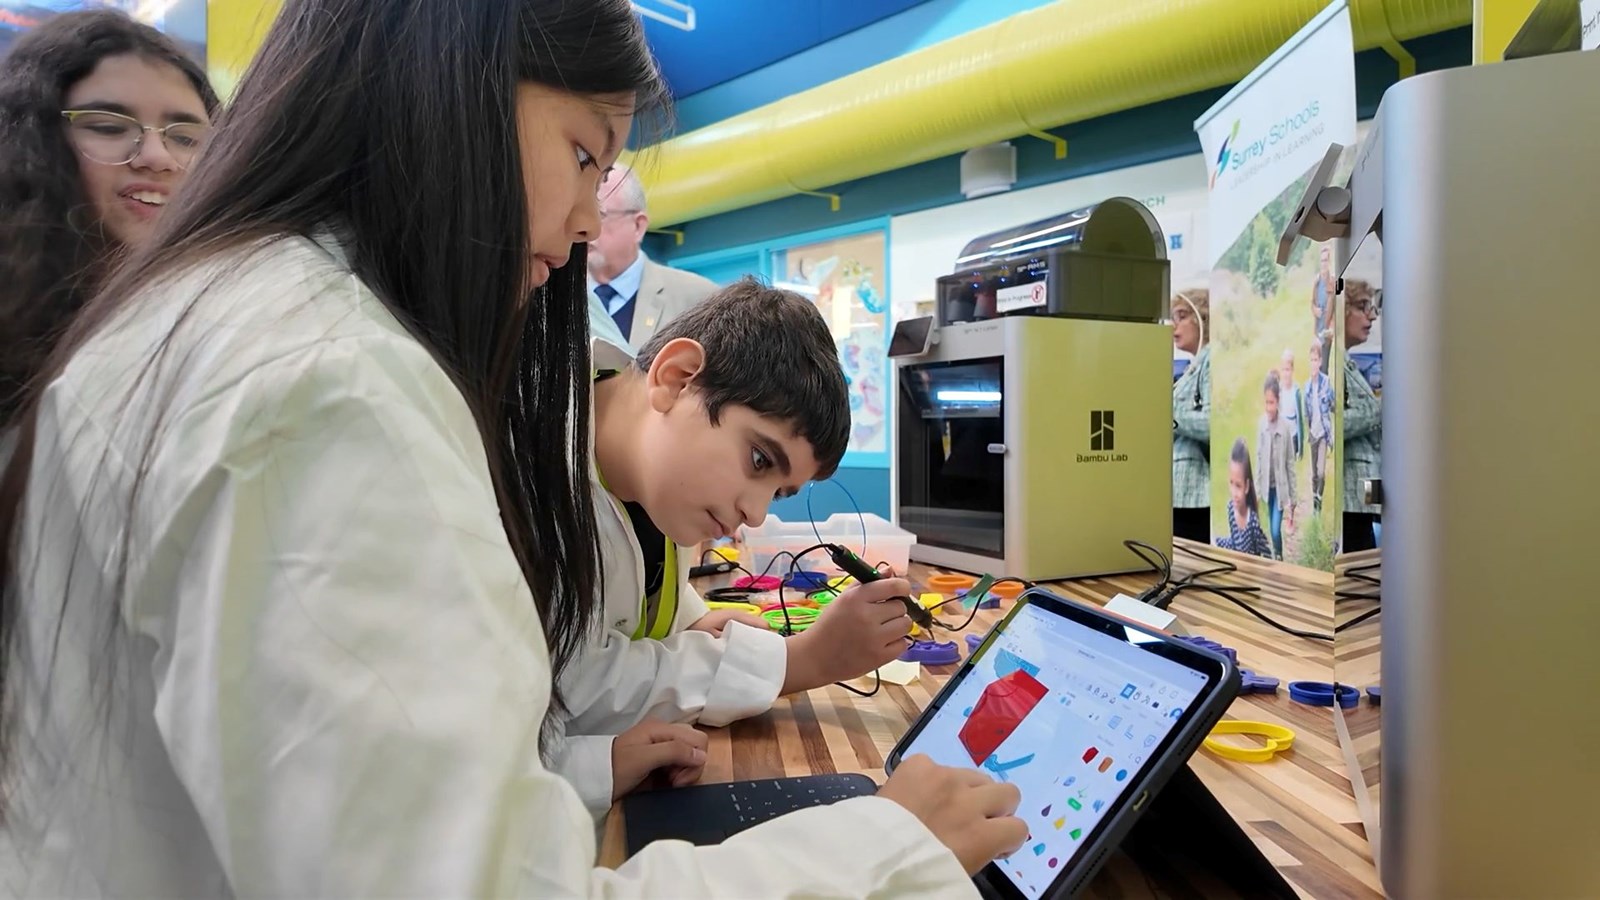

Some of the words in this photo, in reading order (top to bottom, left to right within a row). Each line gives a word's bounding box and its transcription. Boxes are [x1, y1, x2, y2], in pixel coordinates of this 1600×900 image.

[1232, 137, 1266, 171] Surrey
[1269, 100, 1320, 145] Schools
[1283, 122, 1325, 158] LEARNING
[1076, 453, 1109, 463] Bambu
[1111, 453, 1128, 462] Lab
